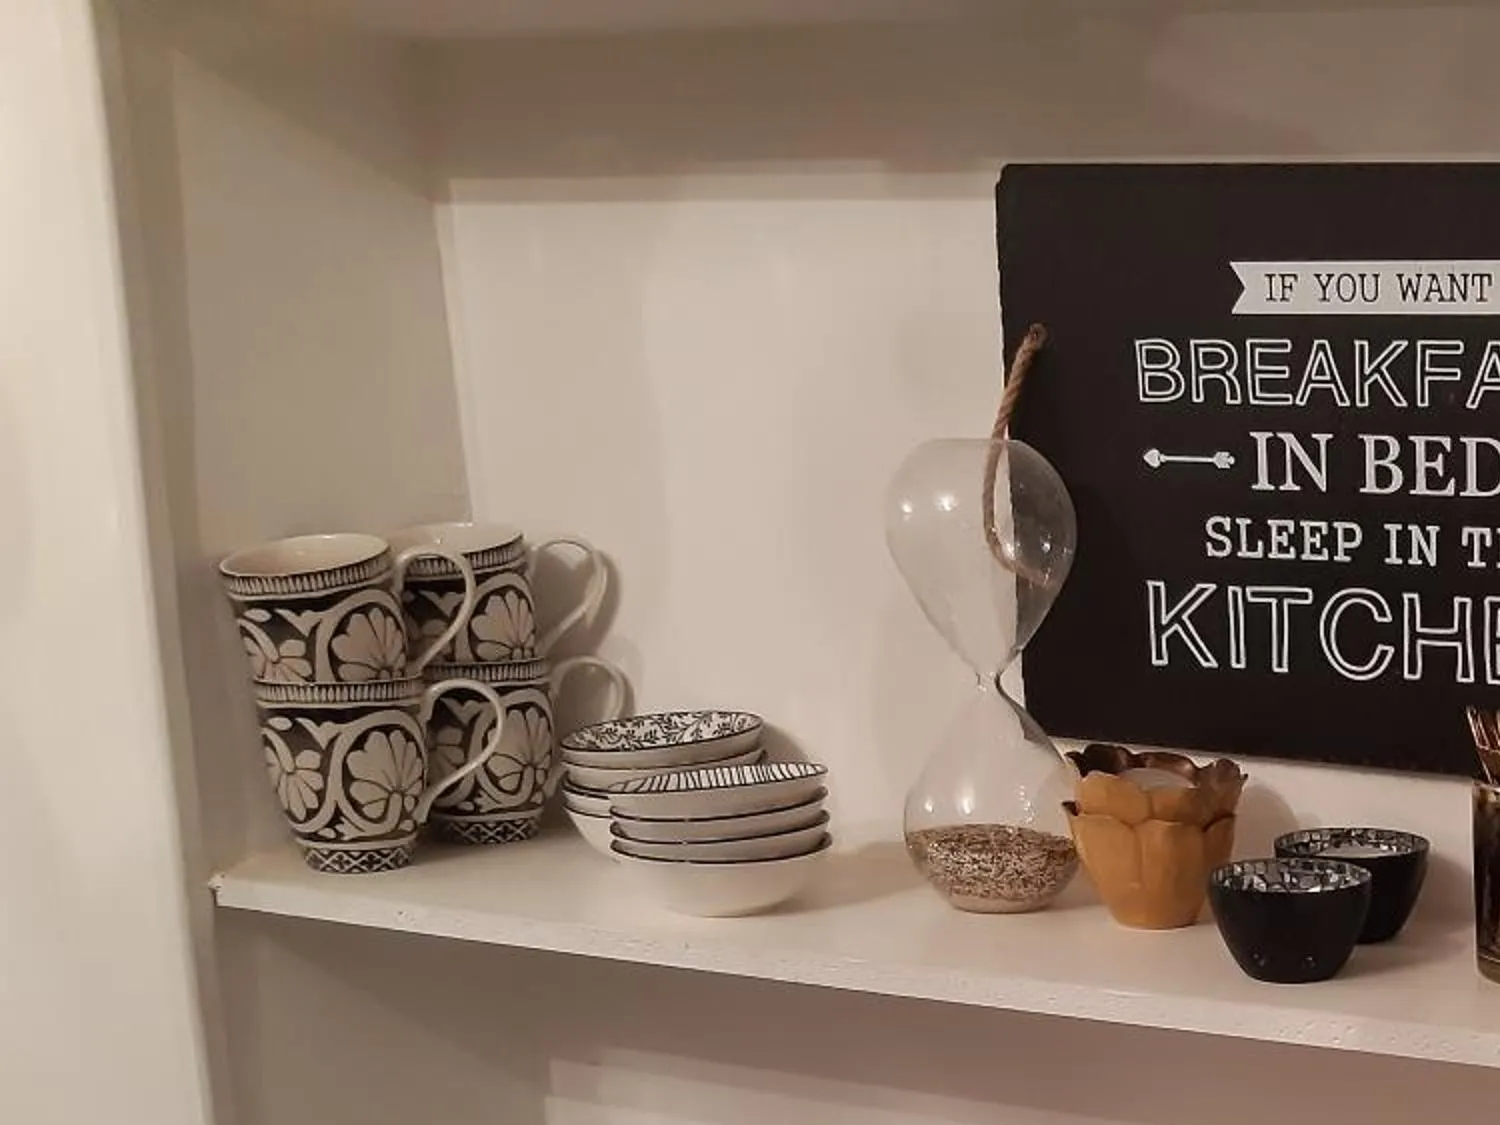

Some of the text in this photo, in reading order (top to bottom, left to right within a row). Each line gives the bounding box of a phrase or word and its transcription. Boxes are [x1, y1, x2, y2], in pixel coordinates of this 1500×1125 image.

[1264, 273, 1493, 303] IF YOU WANT
[1249, 431, 1334, 493] IN
[1205, 515, 1363, 562] SLEEP
[1383, 523, 1441, 568] IN
